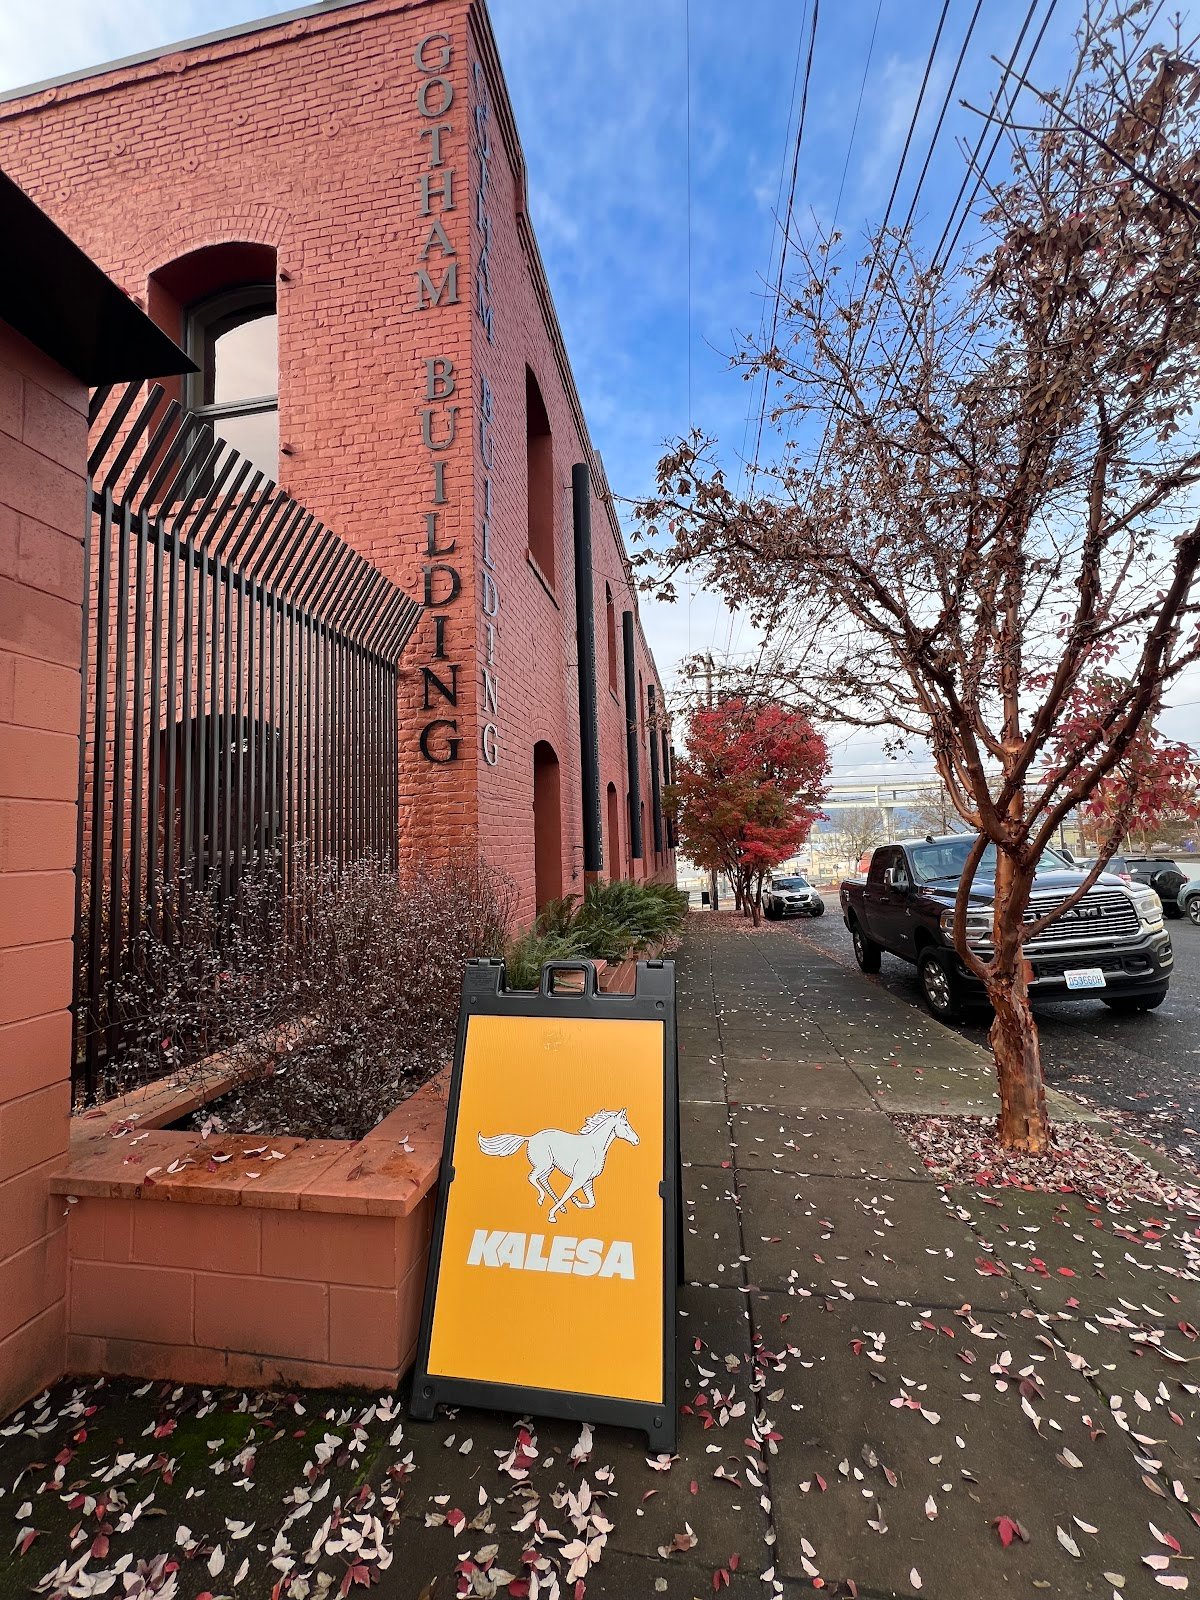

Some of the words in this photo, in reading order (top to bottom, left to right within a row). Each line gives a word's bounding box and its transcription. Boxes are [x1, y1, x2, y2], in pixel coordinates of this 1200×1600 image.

[413, 32, 461, 311] GOTHAM
[419, 355, 463, 766] BUILDING
[480, 372, 499, 767] BUILDING
[466, 1229, 635, 1280] KALESA
